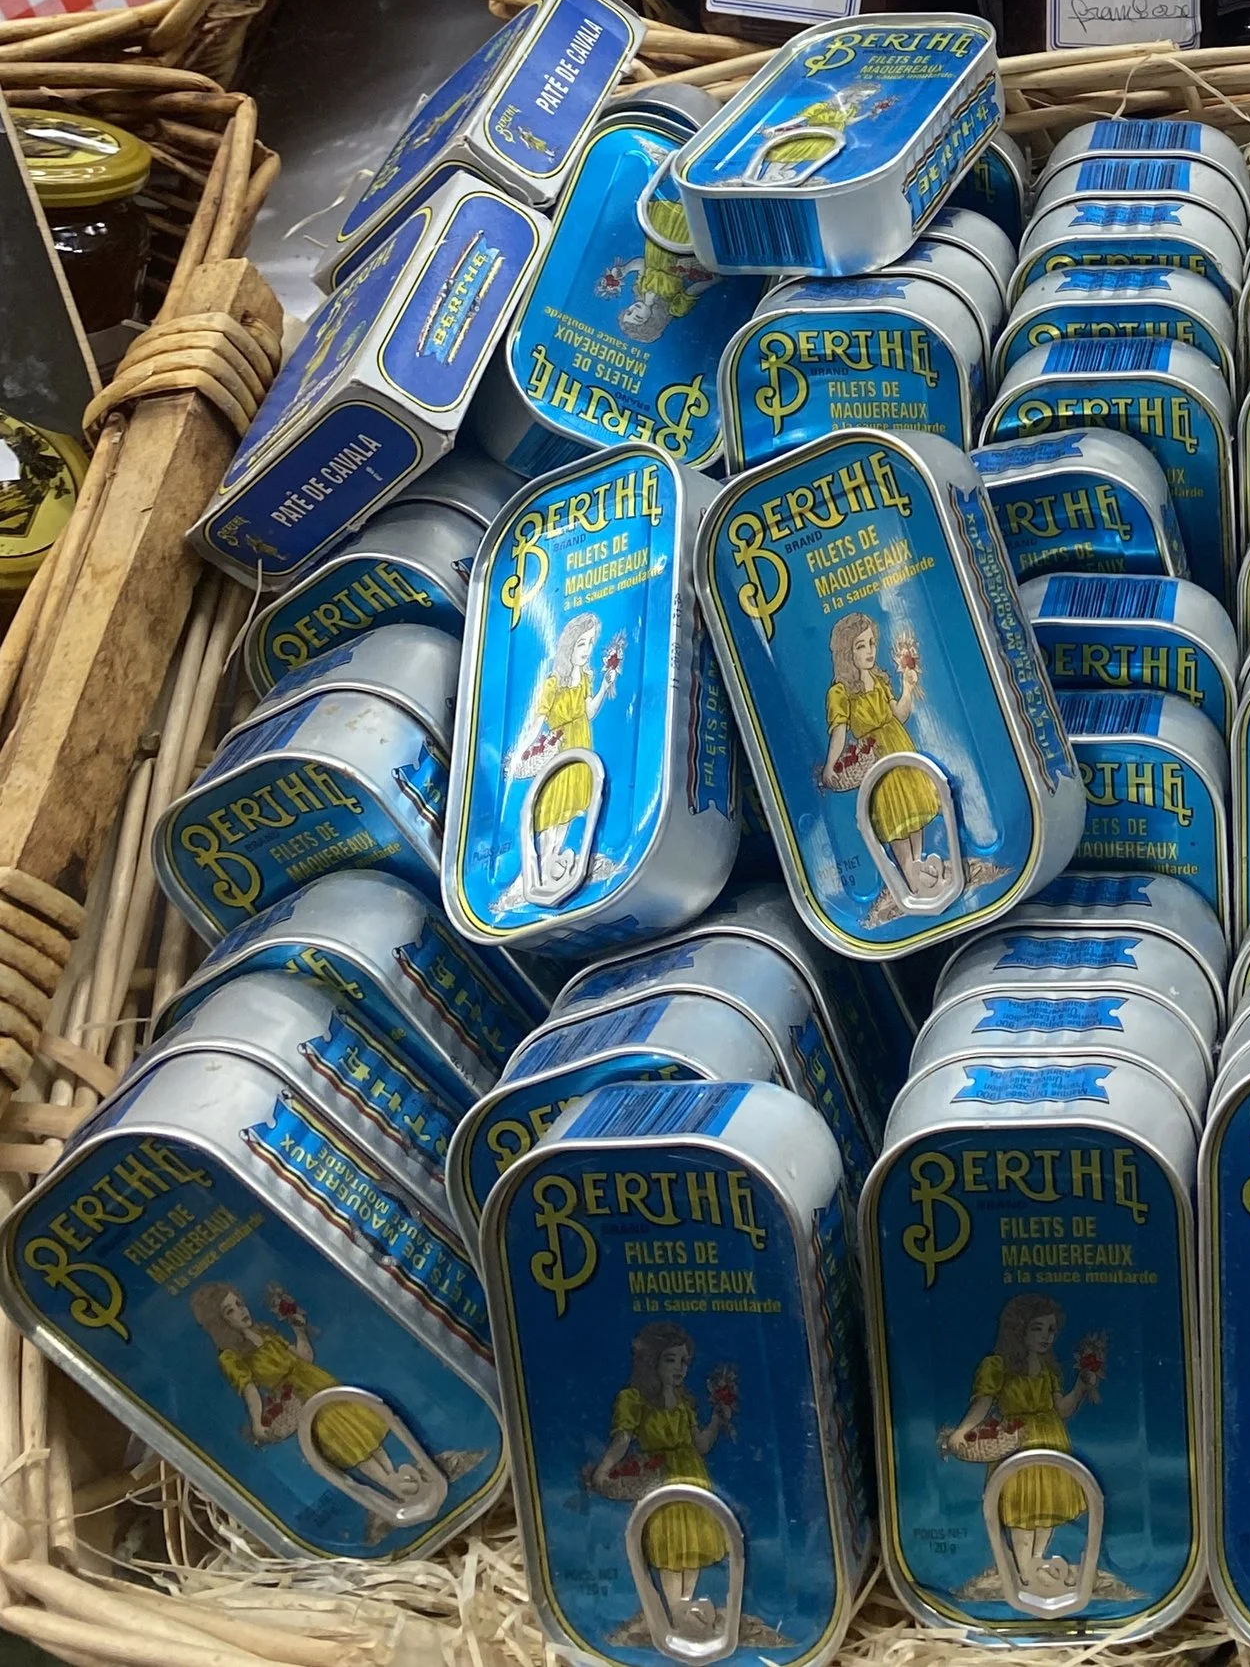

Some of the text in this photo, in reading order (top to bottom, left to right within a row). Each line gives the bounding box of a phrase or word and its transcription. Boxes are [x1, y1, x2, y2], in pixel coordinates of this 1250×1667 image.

[569, 18, 604, 68] CAVALA
[803, 32, 976, 78] BERTHE
[868, 55, 932, 64] FILETS DE
[859, 64, 945, 74] MAQUEREAUX
[433, 249, 488, 347] BERTHE
[553, 324, 647, 378] MAQUEREAUX
[572, 353, 641, 394] FILETS DE
[526, 344, 711, 460] BERTHE
[755, 329, 940, 436] BERTHE
[828, 381, 900, 398] FILETS DE
[830, 403, 929, 420] MAQUEREAUX
[324, 433, 382, 484] CAVALA
[501, 465, 664, 631] BERTHE
[564, 534, 630, 572] FILETS DE
[726, 450, 913, 643] BERTHE
[784, 530, 825, 556] BRAND
[804, 523, 880, 575] FILETS DE
[563, 549, 650, 596] MAQUEREAUX
[813, 538, 913, 601] MAQUEREAUX
[831, 554, 936, 610] la sauce moutarde
[181, 760, 365, 916] BERTHE
[270, 819, 339, 863] FILETS DE
[1126, 815, 1148, 835] DE
[22, 1139, 214, 1344] BERTHE
[124, 1202, 197, 1267] FILETS DE
[530, 1169, 768, 1316] BERTHE
[902, 1148, 1150, 1289] BERTHE
[1000, 1215, 1097, 1239] FILETS DE
[145, 1207, 239, 1285] MAQUEREAUX
[624, 1240, 720, 1265] FILETS DE
[1001, 1244, 1134, 1267] MAQUEREAUX
[628, 1269, 756, 1295] MAQUEREAUX
[1036, 1270, 1160, 1285] sauce moutarde
[710, 1298, 782, 1315] moutarde
